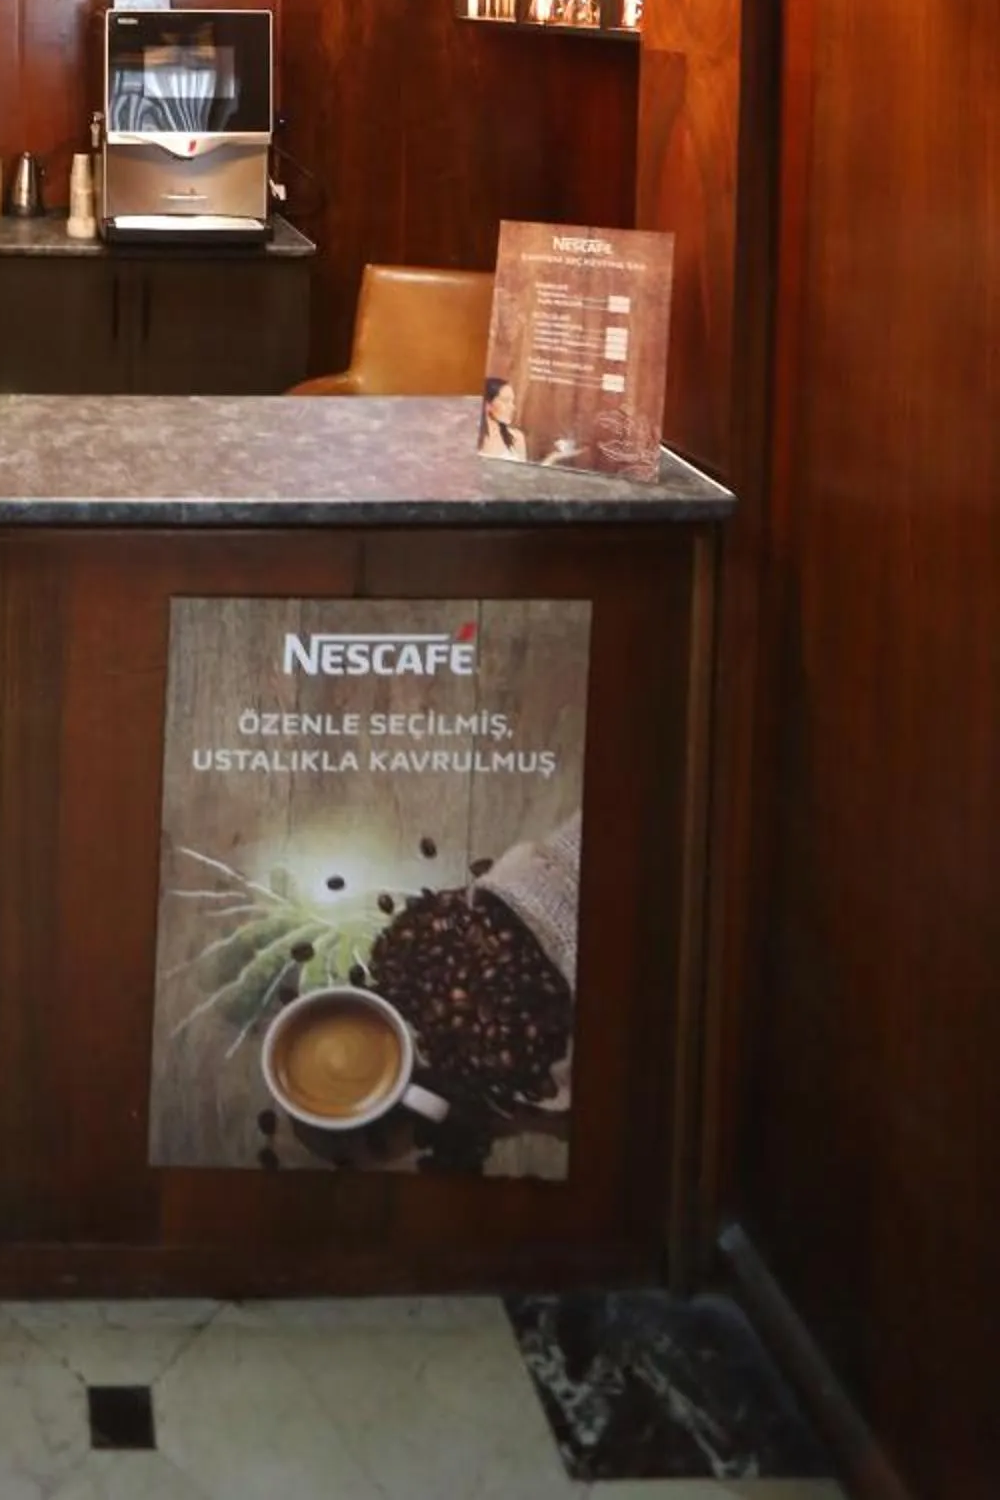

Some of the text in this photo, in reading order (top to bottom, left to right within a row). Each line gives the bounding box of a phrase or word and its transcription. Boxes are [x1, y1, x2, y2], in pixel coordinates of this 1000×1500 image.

[237, 708, 514, 741] ÖZENLE SEÇİLMİŞ,
[192, 749, 556, 779] USTALIKLA KAVRULMUŞ
